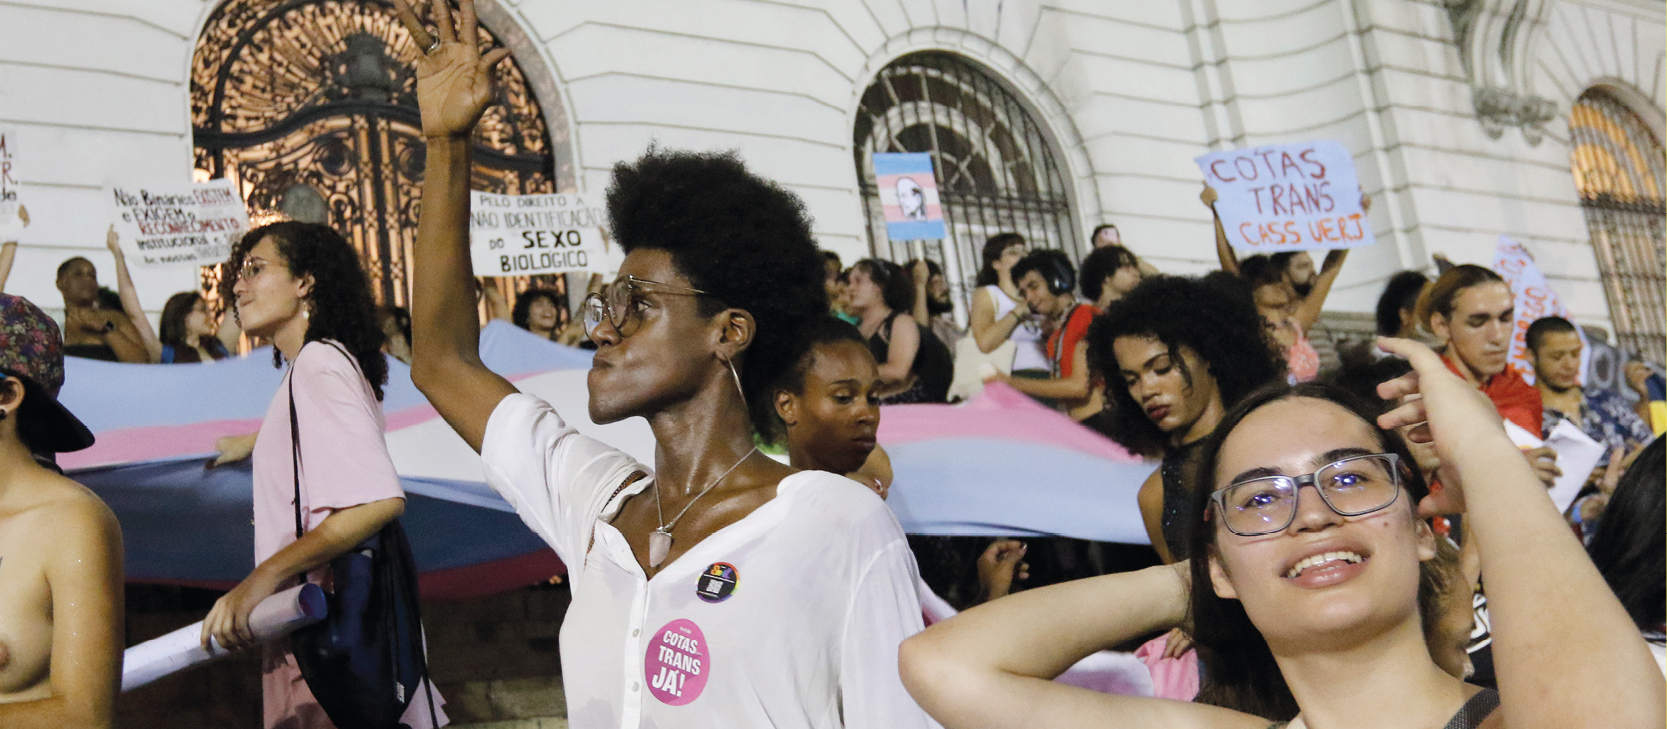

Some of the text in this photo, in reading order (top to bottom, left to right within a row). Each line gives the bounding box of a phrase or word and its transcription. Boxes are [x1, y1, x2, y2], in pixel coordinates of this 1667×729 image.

[1210, 147, 1326, 183] COTAS
[479, 195, 511, 207] PELO
[517, 195, 567, 207] DIREITO
[1248, 181, 1335, 216] TRANS
[139, 217, 240, 235] RECONHECIMENTO
[1238, 221, 1302, 246] CASS
[521, 229, 582, 249] SEXO
[501, 249, 588, 273] BIOLÓGICO
[662, 629, 699, 655] COTAS
[658, 644, 702, 676] TRANS
[651, 666, 686, 698] JÁ!
